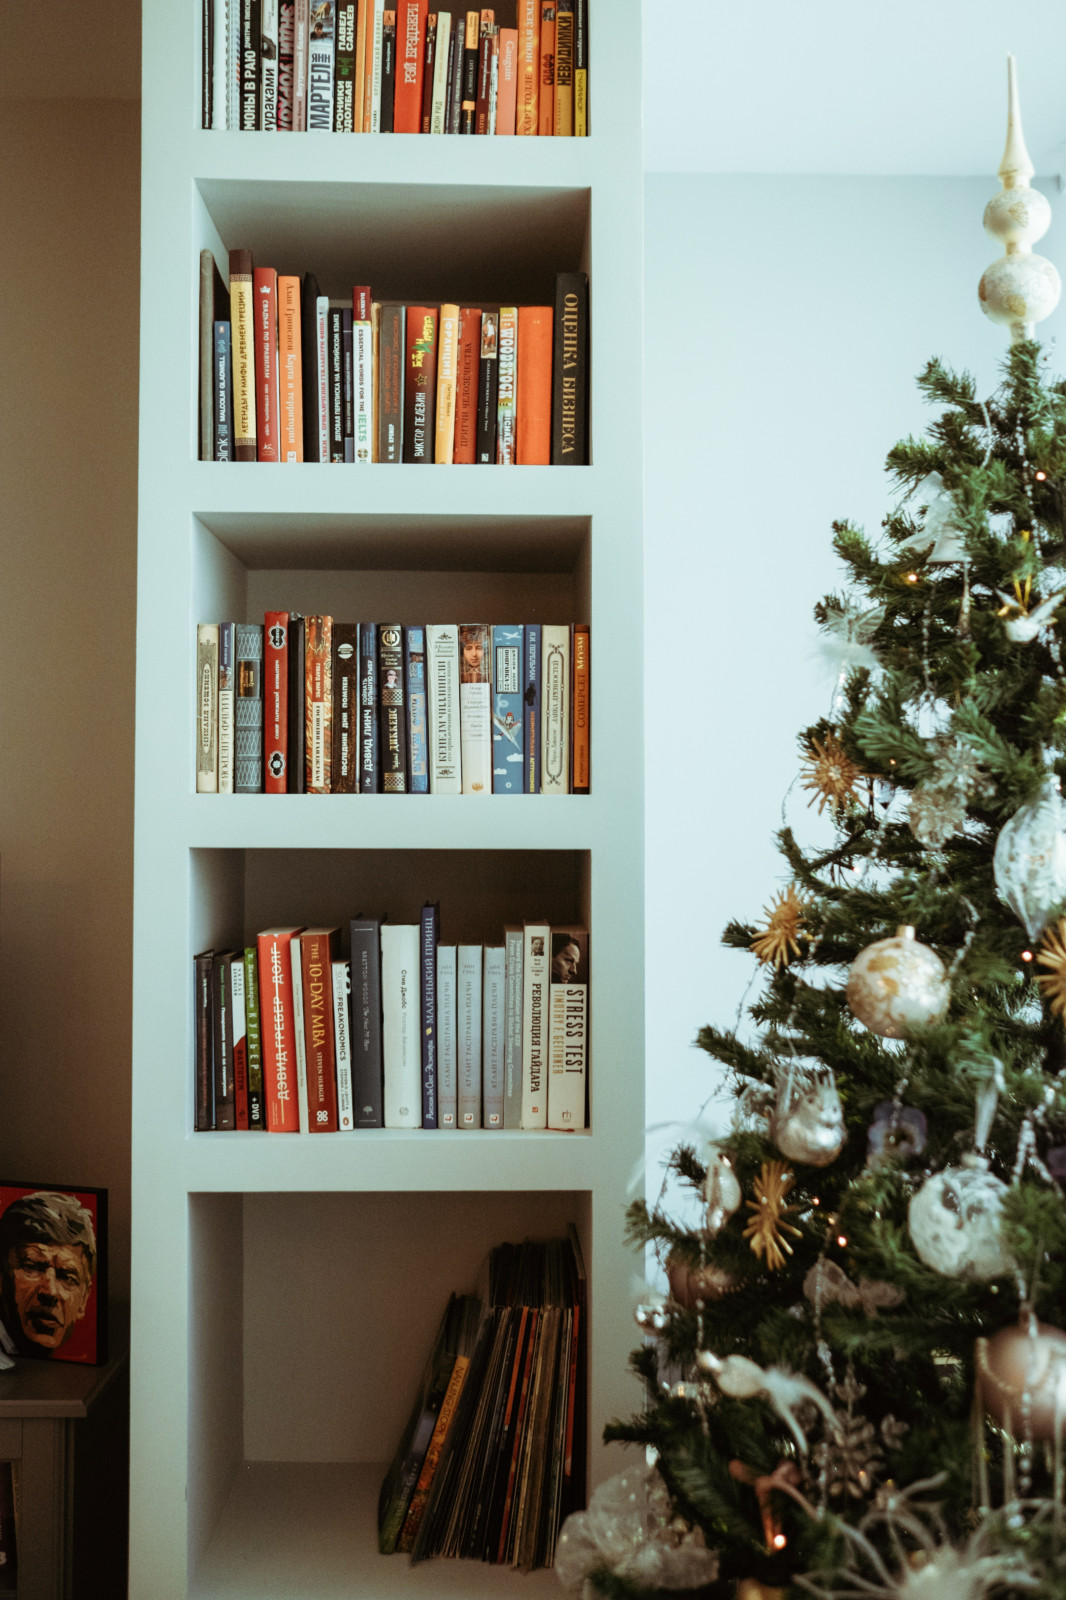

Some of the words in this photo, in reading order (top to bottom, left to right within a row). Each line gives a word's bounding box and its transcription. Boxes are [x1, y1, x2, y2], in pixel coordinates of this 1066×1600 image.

[279, 3, 294, 54] ЭНДИ
[338, 10, 346, 50] ПАВЕЛ
[346, 4, 354, 52] САНАЕВ
[405, 3, 419, 59] БРЭДБЕРИ
[311, 53, 331, 64] ЯНН
[503, 40, 514, 80] Gauguin
[525, 29, 534, 63] НОВАЯ
[557, 16, 572, 87] НЕВИДИМКИ
[244, 50, 256, 79] РАЮ
[404, 62, 416, 84] РЭЙ
[543, 54, 555, 86] СНАФФ
[244, 82, 256, 91] В
[310, 64, 330, 130] МАРТЕЛ
[524, 74, 533, 107] ТОЛЛЕ
[244, 94, 256, 130] МОНЫ
[345, 81, 353, 133] ЗДОЛБАЯ
[434, 101, 443, 114] РИД
[238, 291, 246, 322] ГРЕЦИИ
[286, 283, 294, 304] Алан
[262, 300, 270, 330] СВАДЬБА
[560, 293, 578, 370] ОЦЕНКА
[238, 324, 247, 360] ДРЕВНЕЙ
[263, 331, 270, 340] ПО
[239, 362, 247, 388] МИФЫ
[287, 354, 296, 380] Карта
[334, 372, 340, 381] НА
[461, 342, 472, 409] ЧЕЛОВЕЧЕСТВА
[499, 327, 514, 399] WOODSTOCK
[240, 398, 248, 433] ЛЕГЕНДЫ
[286, 392, 296, 443] территория
[414, 392, 426, 426] ПЕЛЕВИН
[561, 377, 576, 454] БИЗНЕСА
[334, 416, 342, 442] ДЕЛОВАЯ
[359, 414, 367, 442] IELTS
[414, 429, 425, 457] ВИКТОР
[460, 412, 469, 447] ПРИТЧИ
[504, 410, 512, 447] MICHAEL
[503, 448, 512, 464] LAN
[576, 672, 586, 728] СОМЕРСЕТ
[341, 713, 349, 729] ДНИ
[364, 710, 372, 736] ЛИНЧ
[388, 708, 399, 752] ДИККЕНС
[363, 739, 373, 771] ДЭВИД
[311, 943, 319, 960] THE
[424, 916, 434, 956] ПРИНЦ
[270, 947, 284, 985] ДОЛГ
[310, 963, 324, 1011] 10-DAY
[400, 986, 408, 1009] Джобс
[424, 958, 434, 1025] МАЛЕНЬКИЙ
[273, 996, 285, 1048] ГРЕБЕР
[335, 971, 346, 1061] SUPERFREAKONOMICS
[531, 983, 542, 1046] РЕВОЛЮЦИЯ
[553, 989, 564, 1024] TIMOTHY
[566, 989, 584, 1037] STRESS
[249, 1012, 259, 1070] КУРЬЕР
[311, 1014, 325, 1048] MBA
[530, 1049, 542, 1093] ГАЙДАРА
[552, 1036, 564, 1075] GEITHNER
[566, 1045, 583, 1075] TEST
[275, 1051, 290, 1101] ДЭВИД
[317, 1076, 325, 1103] SILBIGER
[251, 1104, 259, 1120] DVD
